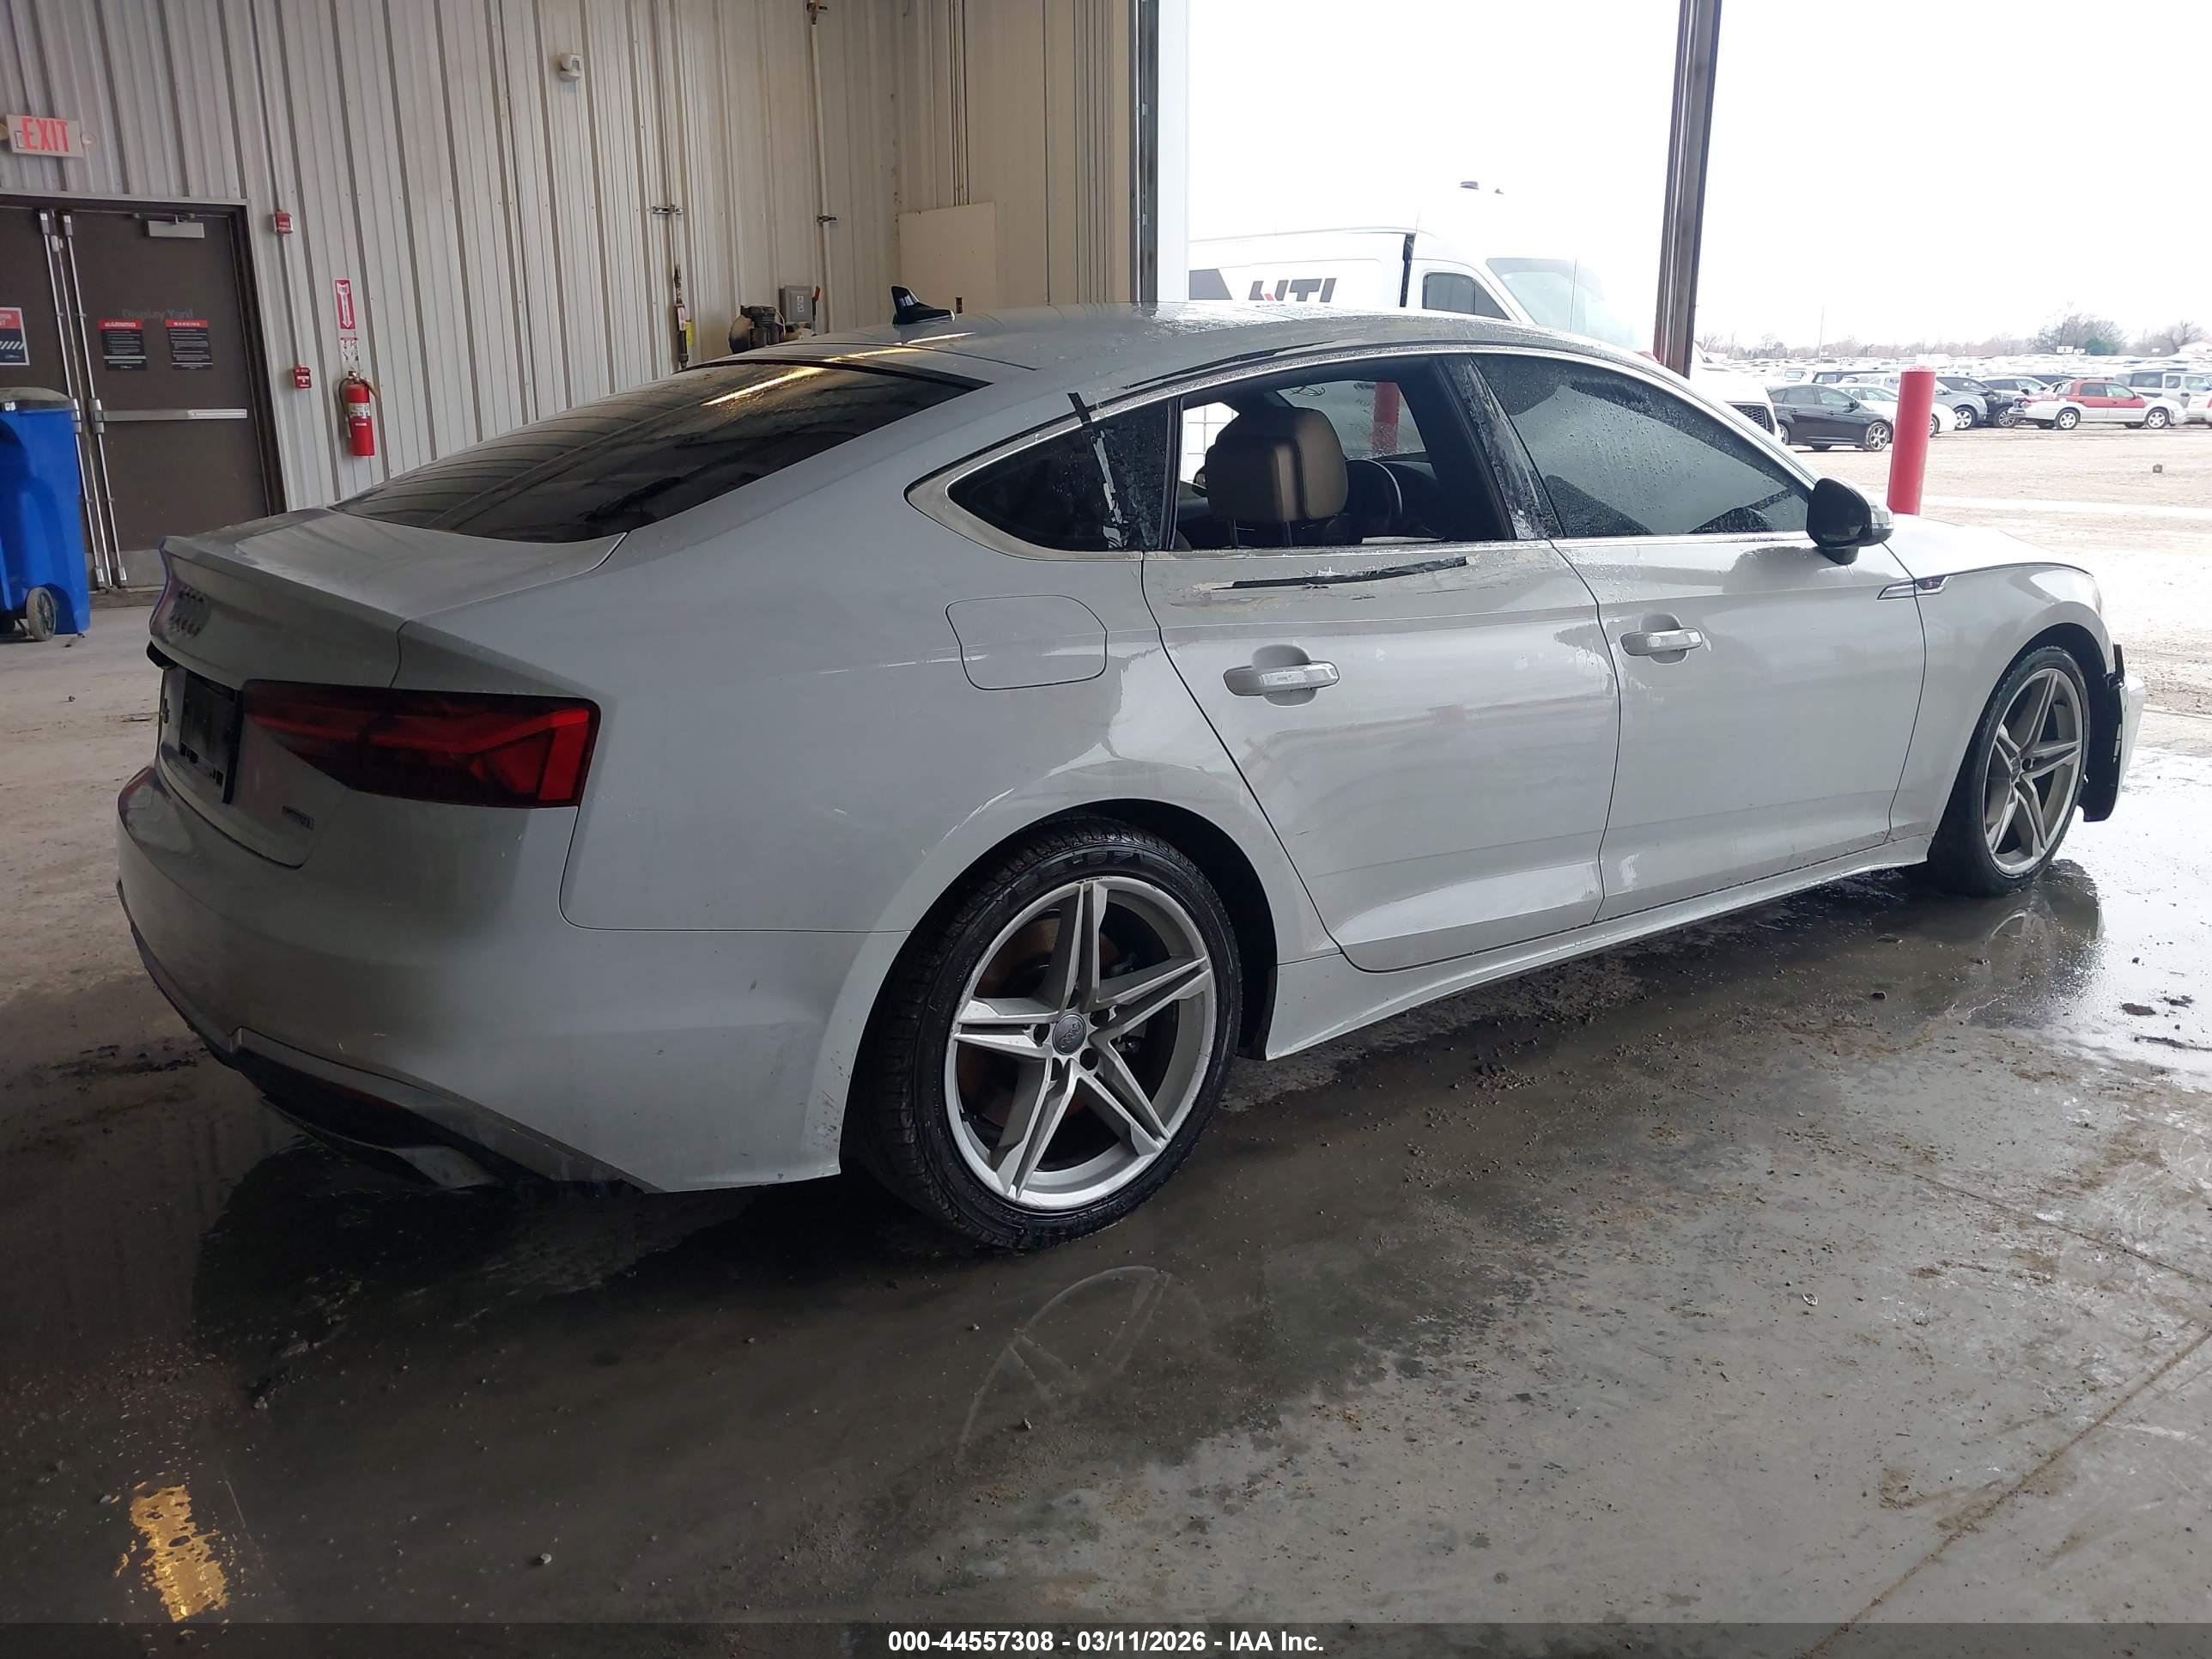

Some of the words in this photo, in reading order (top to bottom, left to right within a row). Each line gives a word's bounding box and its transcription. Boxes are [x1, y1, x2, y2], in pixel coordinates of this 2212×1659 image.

[21, 117, 70, 152] EXIT
[121, 308, 166, 323] Display
[167, 308, 194, 319] Yard
